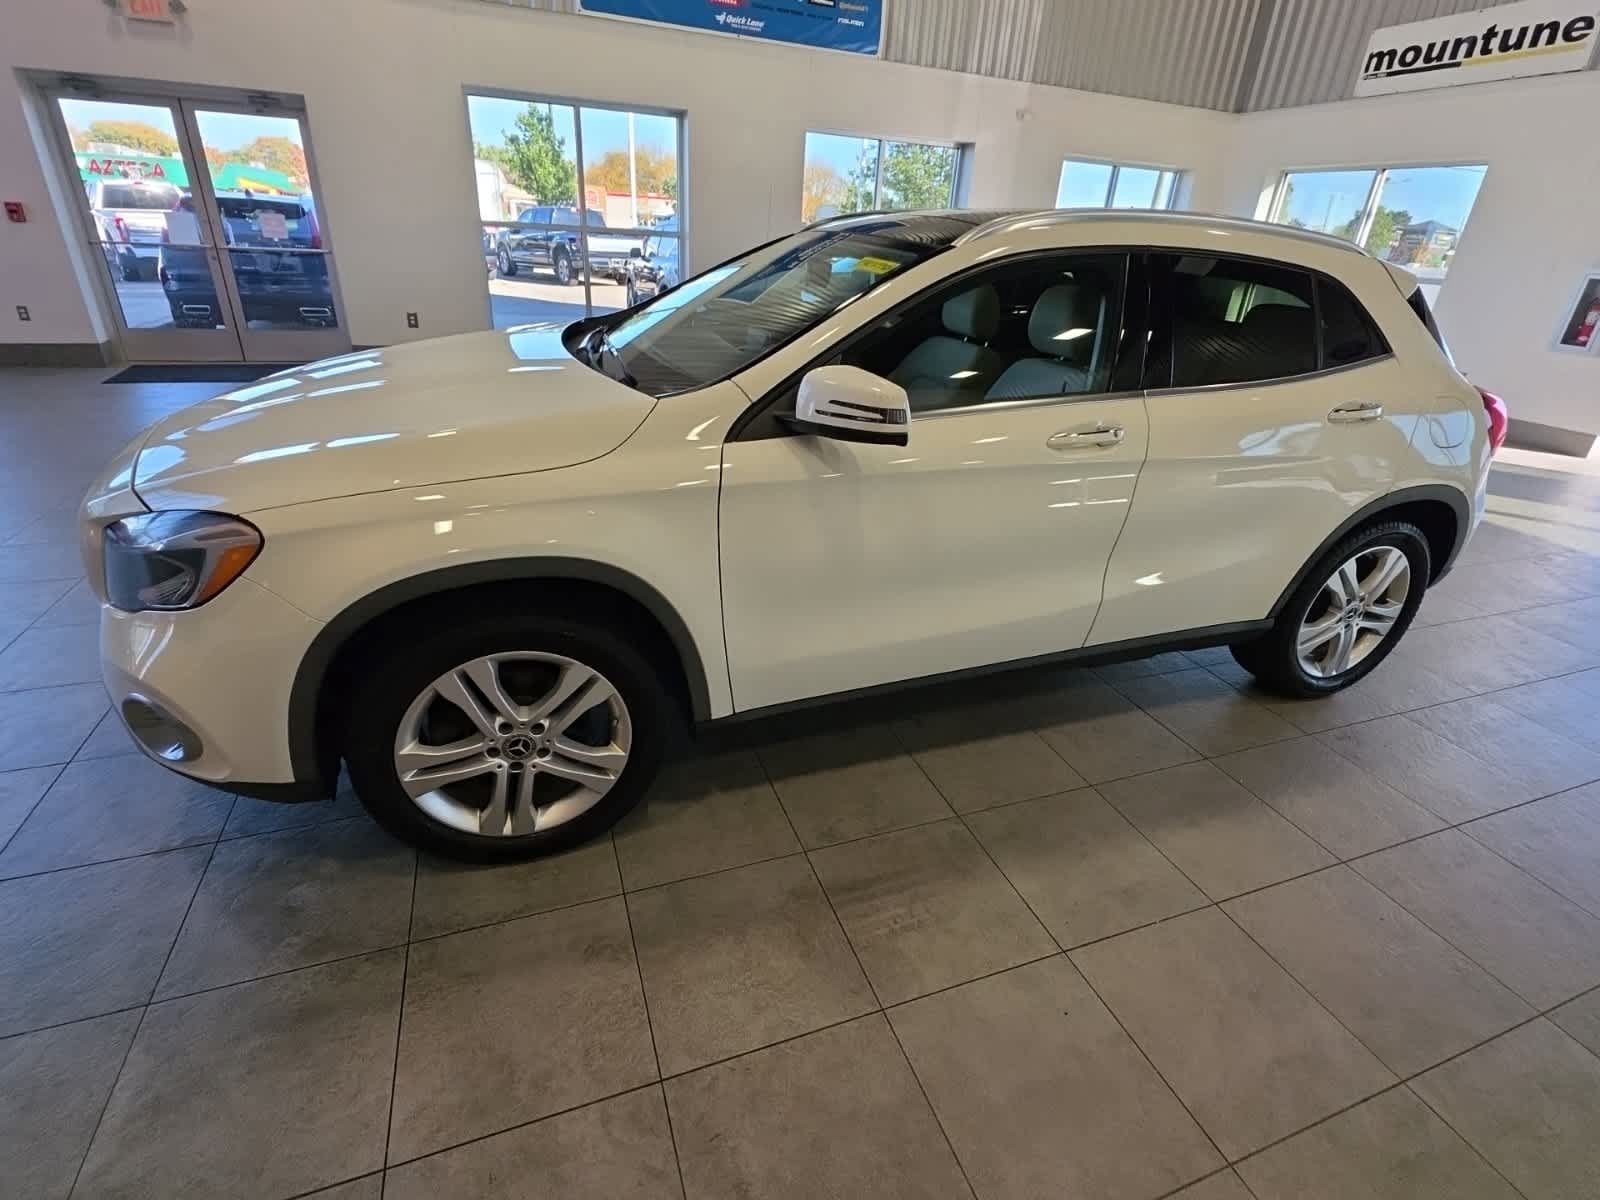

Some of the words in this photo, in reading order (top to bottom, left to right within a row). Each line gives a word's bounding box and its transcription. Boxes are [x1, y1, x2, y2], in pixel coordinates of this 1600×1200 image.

[726, 14, 747, 25] Quick
[747, 18, 765, 28] Lane
[1364, 15, 1596, 74] mountune
